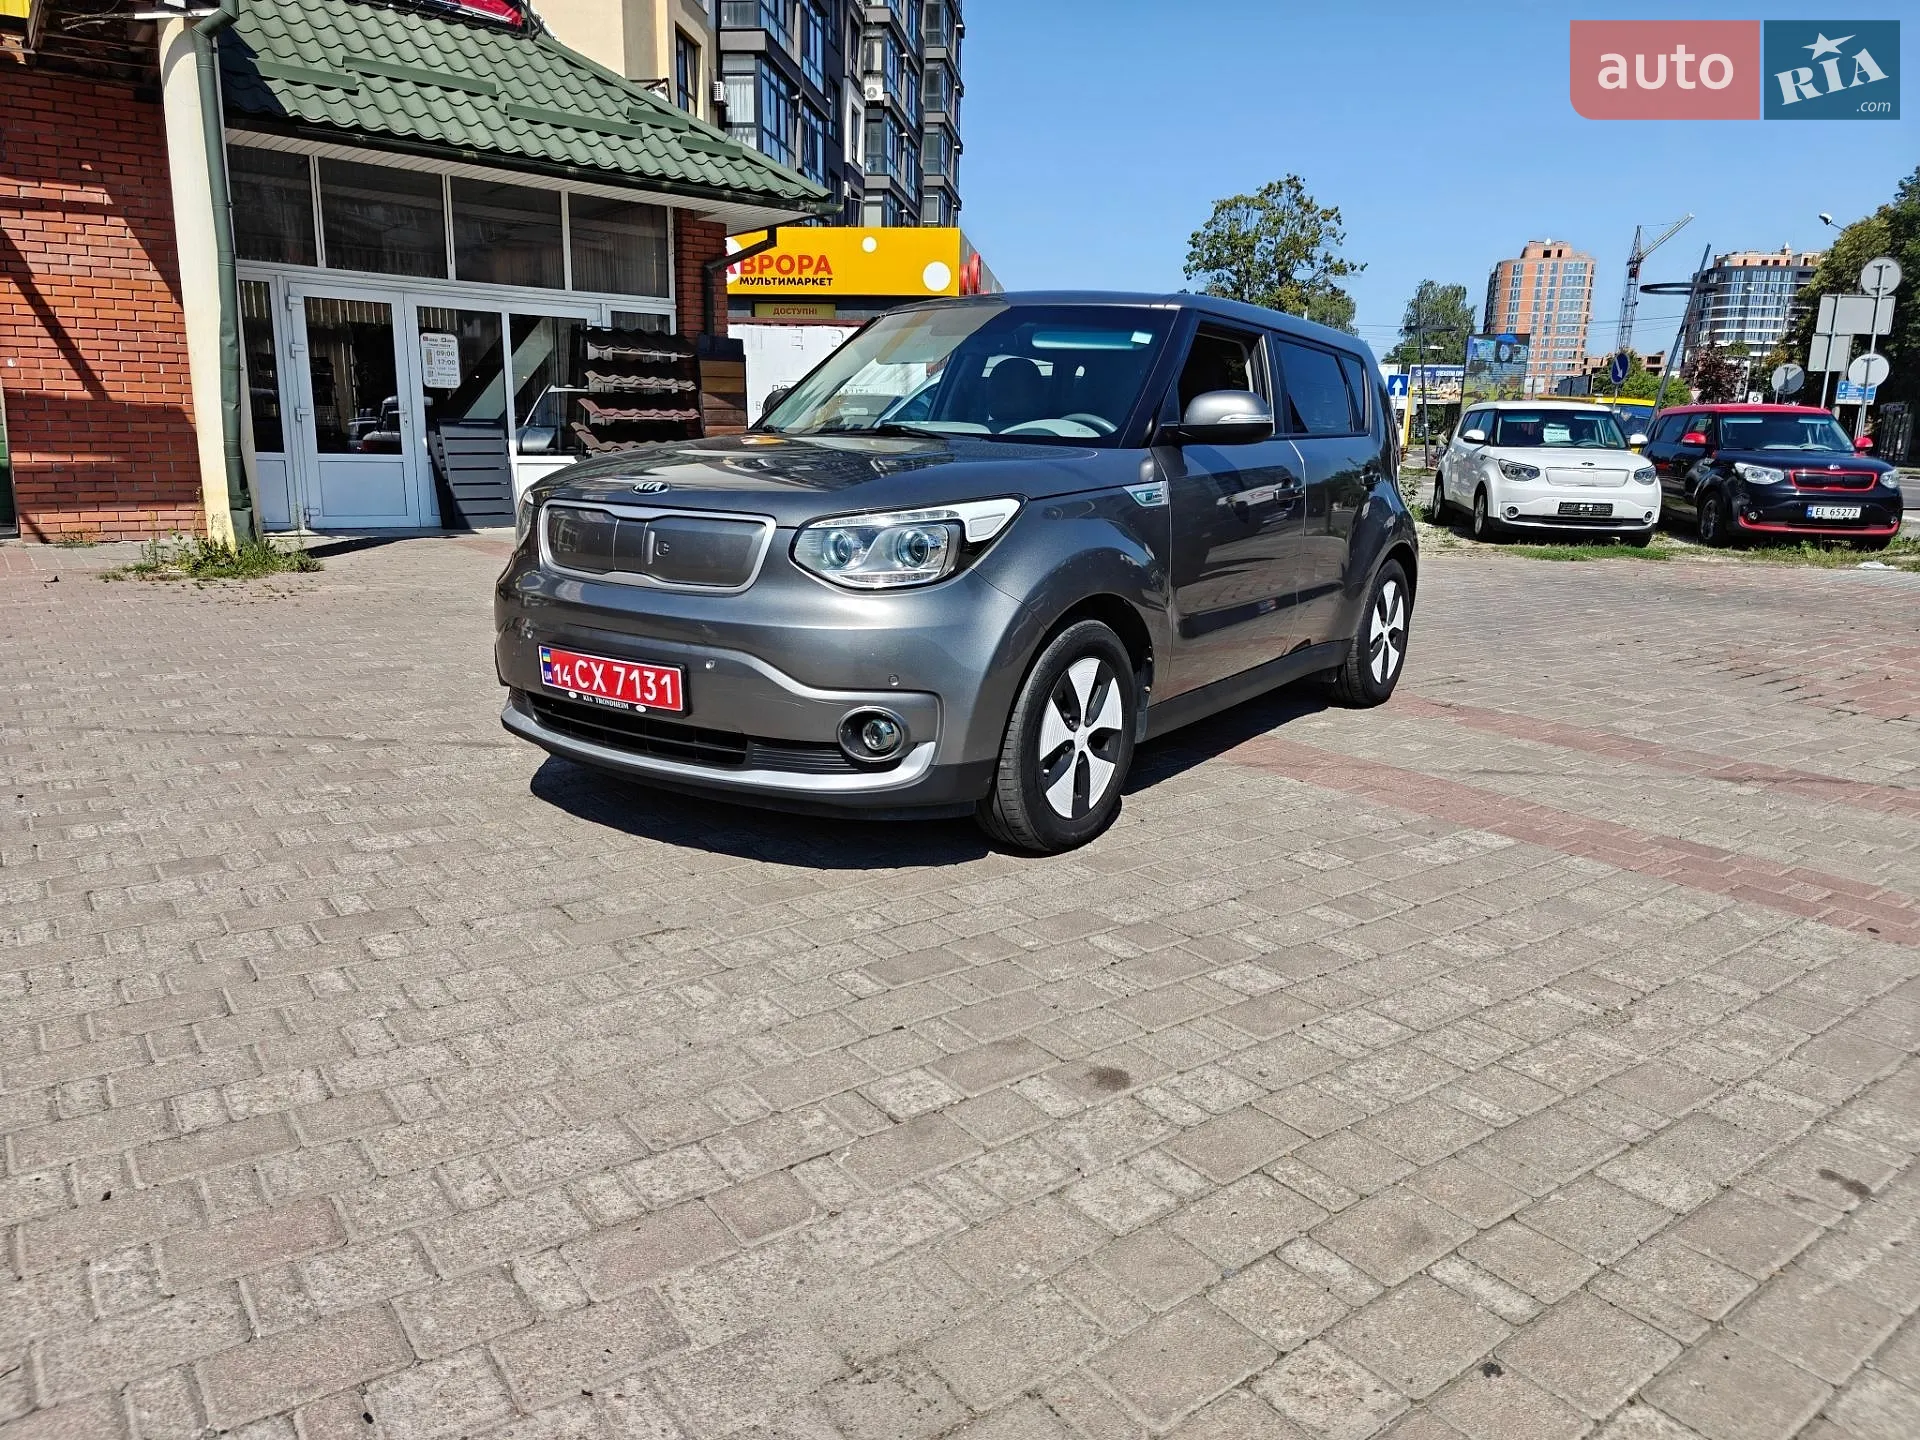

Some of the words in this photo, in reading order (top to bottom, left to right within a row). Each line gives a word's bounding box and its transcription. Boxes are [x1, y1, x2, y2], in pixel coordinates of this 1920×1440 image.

[739, 277, 833, 286] МУЛЬТИМАРКЕТ
[773, 307, 817, 315] ДОСТУПНІ
[1816, 508, 1824, 516] EL
[544, 671, 553, 681] UA
[612, 665, 673, 704] 7131
[595, 697, 629, 710] TRONDHEIM
